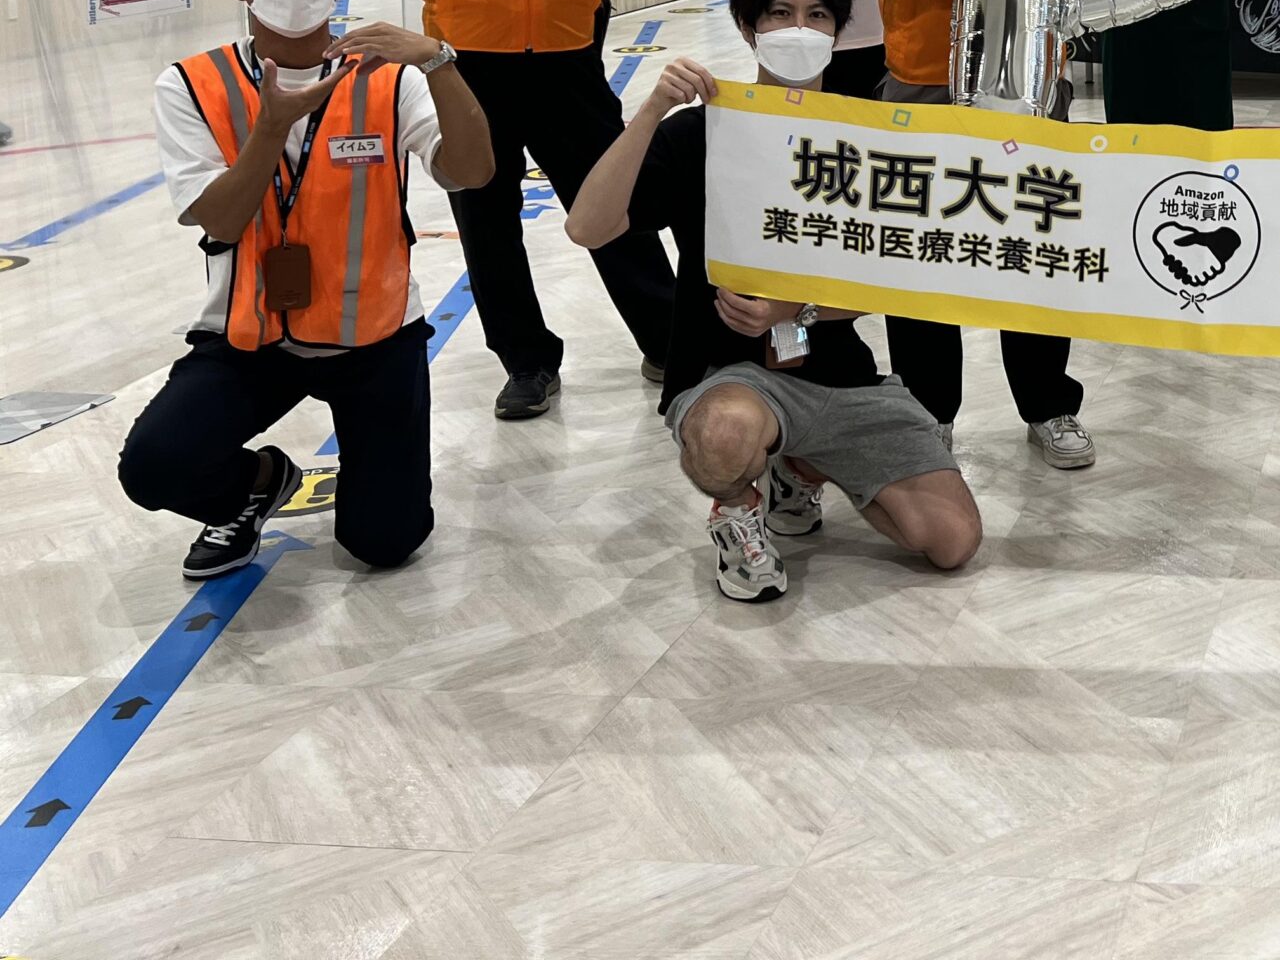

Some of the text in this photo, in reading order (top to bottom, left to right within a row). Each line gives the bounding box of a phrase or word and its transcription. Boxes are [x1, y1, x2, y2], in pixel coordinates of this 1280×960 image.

[337, 141, 376, 152] イイムラ
[791, 137, 1082, 234] 城西大学
[1174, 185, 1225, 201] Amazon
[1160, 197, 1237, 222] 地域貢献
[763, 206, 1110, 283] 薬学部医療栄養学科
